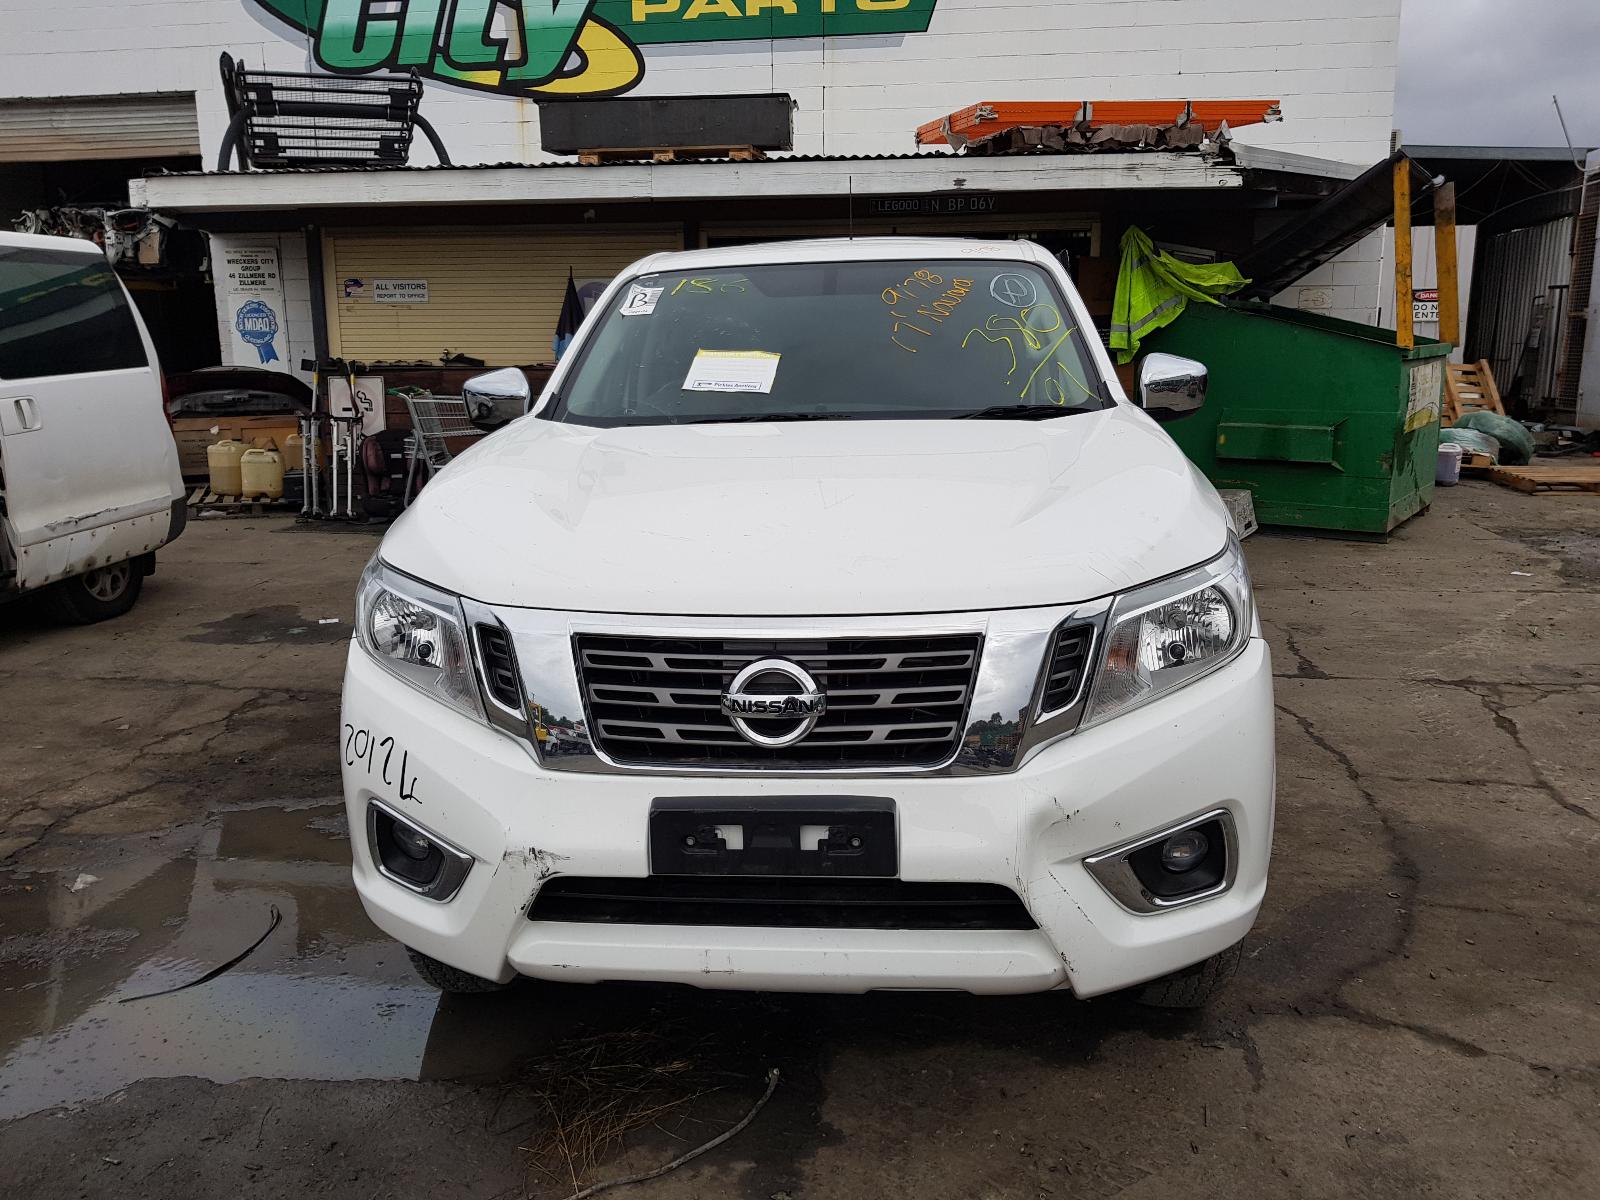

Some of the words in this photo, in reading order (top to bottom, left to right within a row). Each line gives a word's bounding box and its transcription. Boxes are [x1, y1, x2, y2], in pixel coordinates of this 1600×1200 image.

[375, 283, 390, 291] ALL
[392, 283, 427, 291] VISITORS
[1413, 303, 1428, 311] DO
[731, 699, 815, 714] NISSAN
